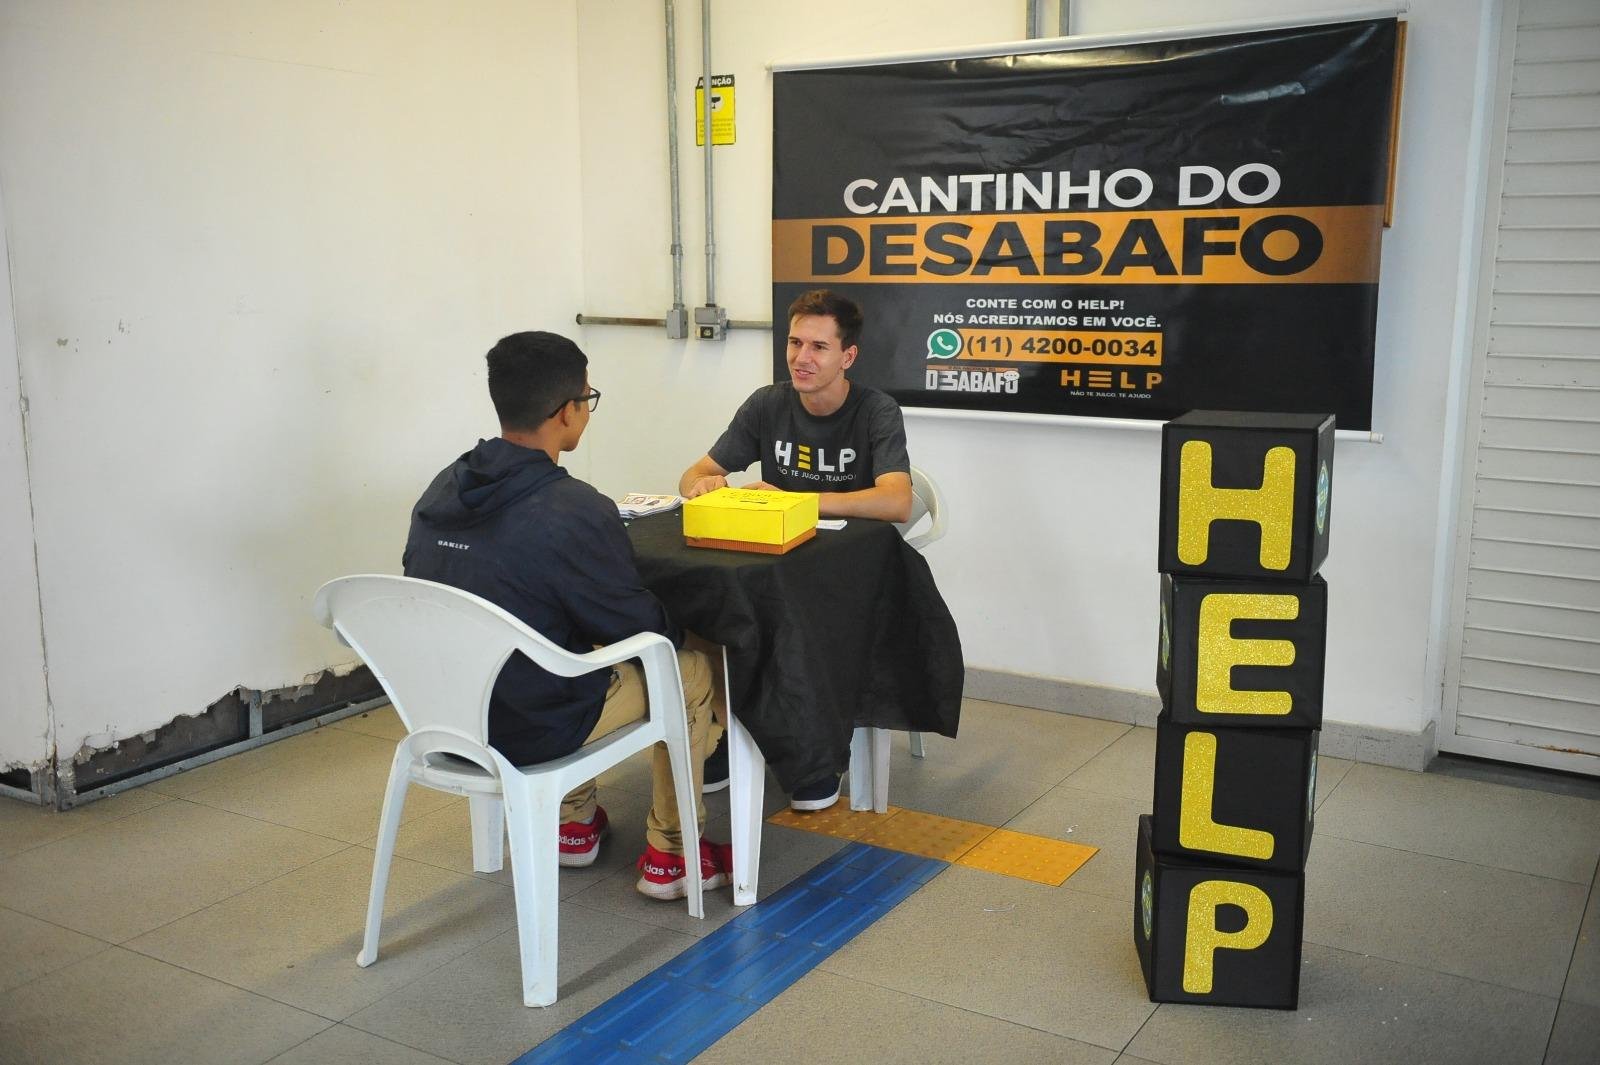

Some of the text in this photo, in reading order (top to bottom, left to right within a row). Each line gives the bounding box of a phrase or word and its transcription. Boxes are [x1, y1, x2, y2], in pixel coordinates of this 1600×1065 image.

[698, 77, 732, 87] ANÇÃO
[843, 163, 1281, 214] CANTINHO DO
[811, 214, 1324, 276] DESABAFO
[966, 298, 1125, 310] CONTE COM O HELP!
[933, 312, 1162, 328] NÓS ACREDITAMOS EM VOCÊ.
[967, 335, 1157, 357] (11) 4200-0034
